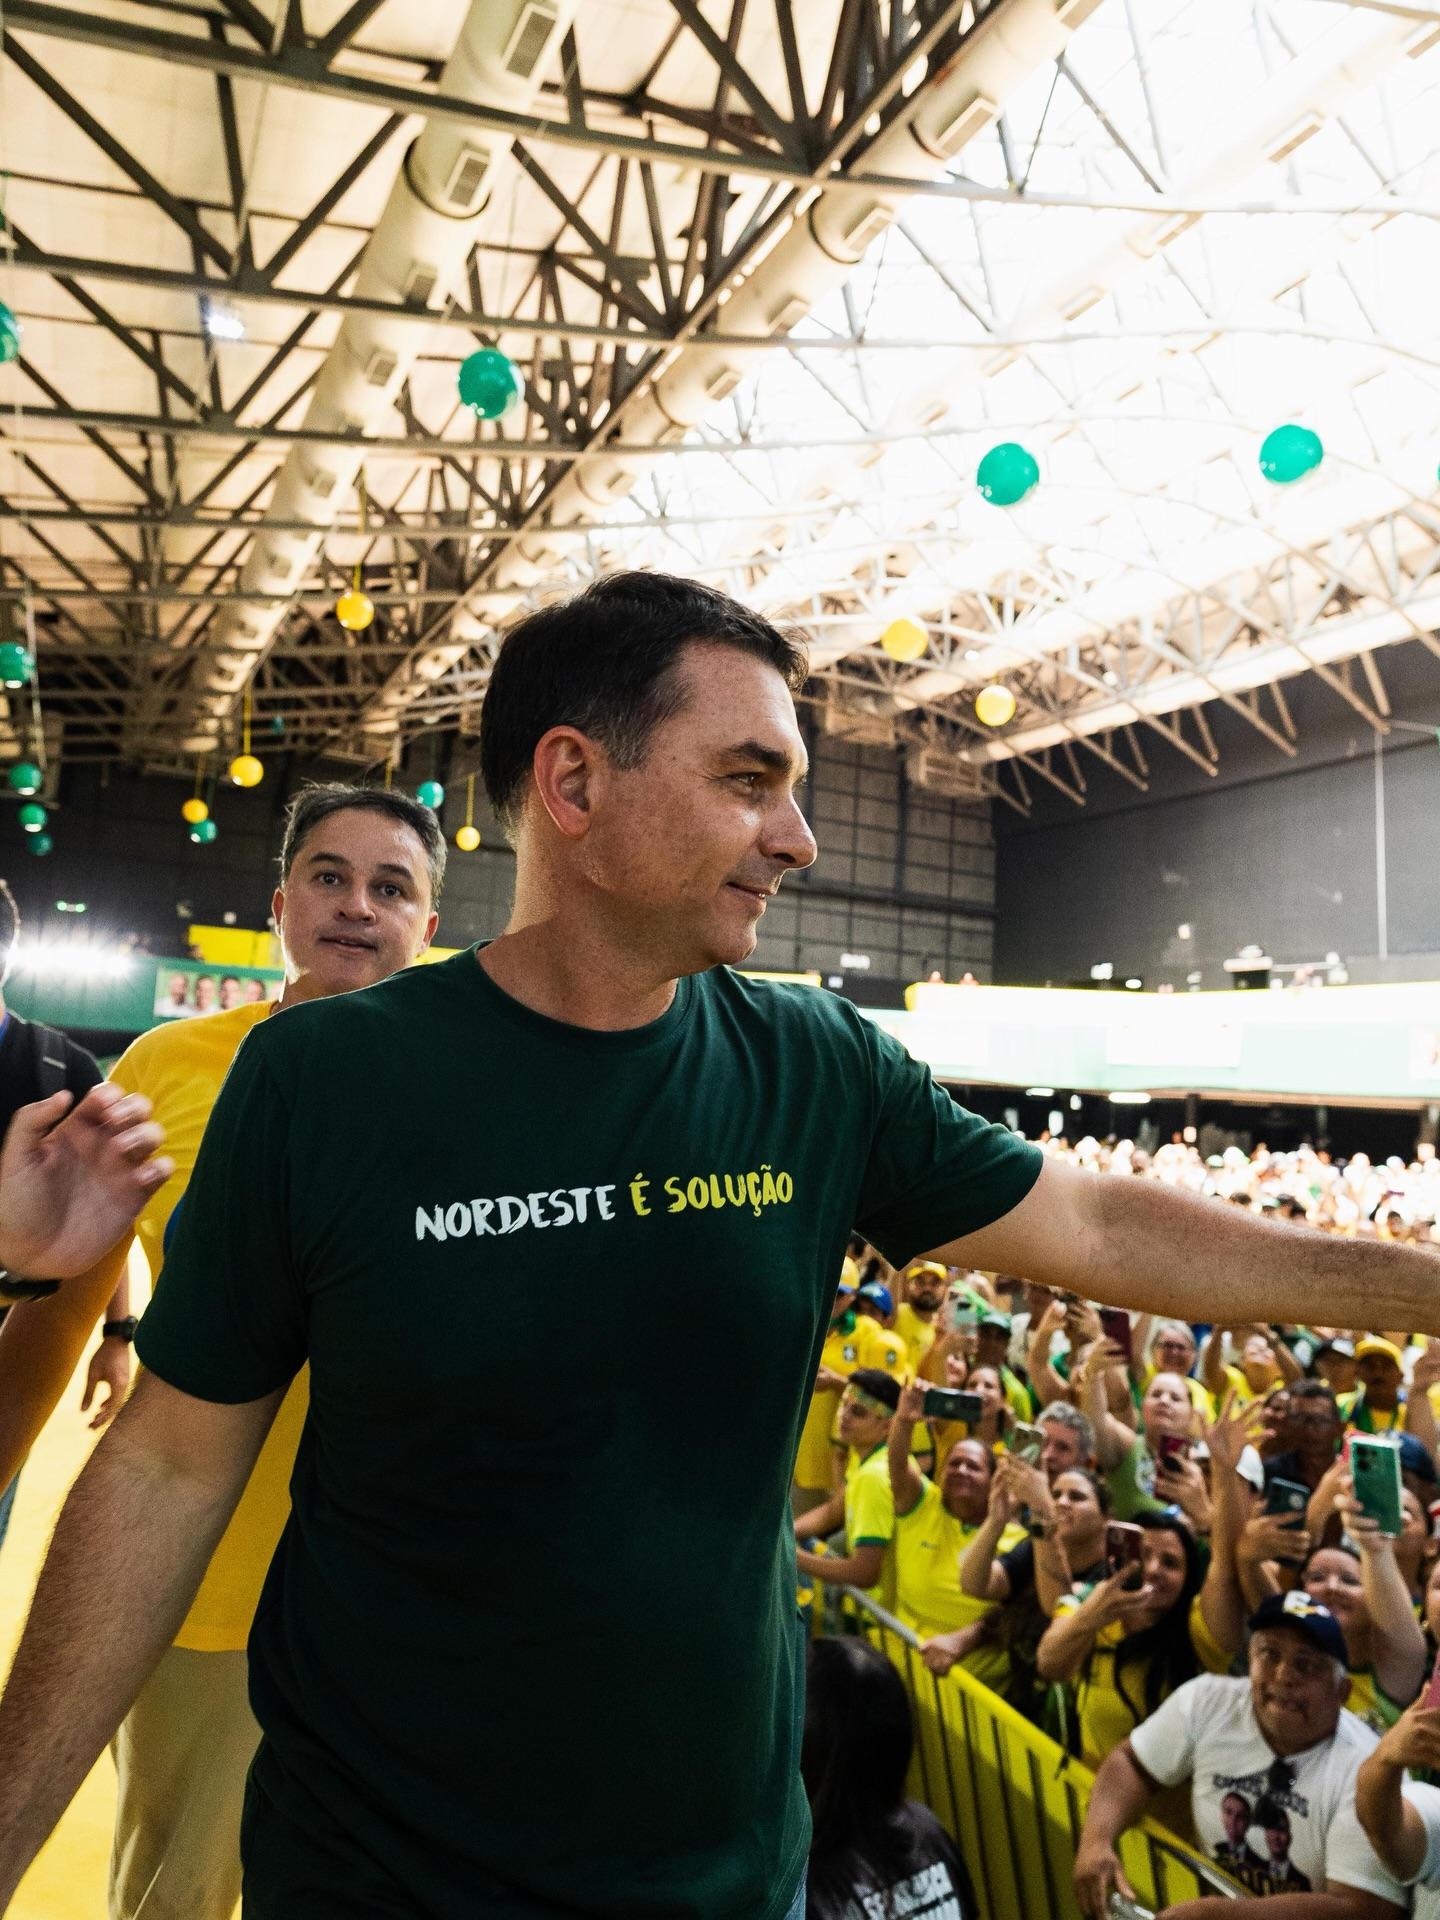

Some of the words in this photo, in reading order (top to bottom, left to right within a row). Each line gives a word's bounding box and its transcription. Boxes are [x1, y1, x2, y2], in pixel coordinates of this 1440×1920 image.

[415, 1184, 616, 1242] NORDESTE
[629, 1172, 651, 1216] É
[664, 1164, 793, 1217] SOLUÇÃO
